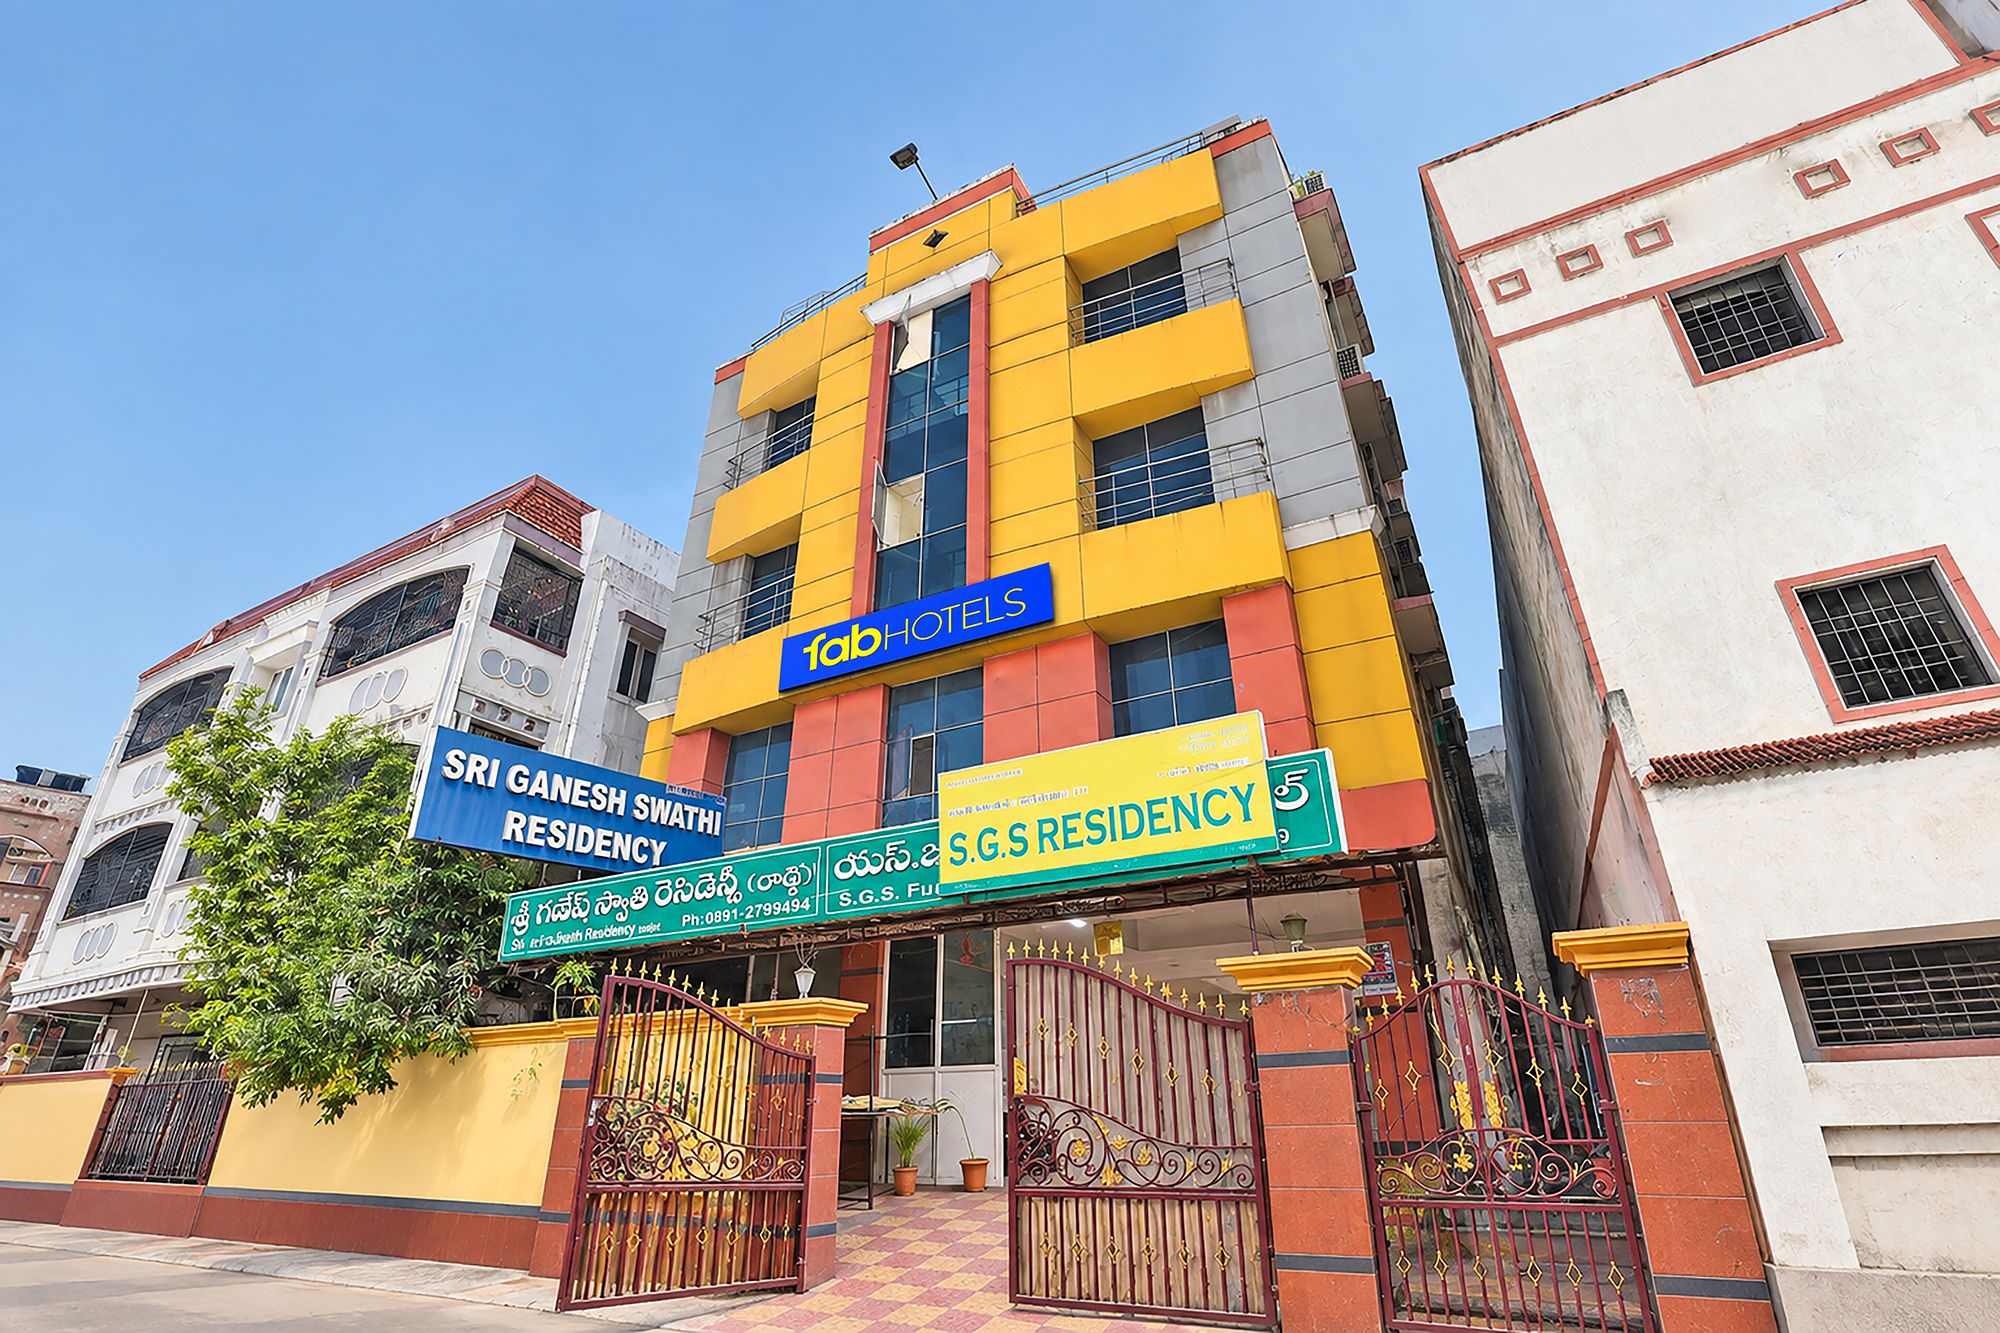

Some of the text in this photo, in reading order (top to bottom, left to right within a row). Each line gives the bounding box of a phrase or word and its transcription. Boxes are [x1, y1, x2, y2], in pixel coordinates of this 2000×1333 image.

[803, 588, 1027, 671] fabHOTELS
[441, 749, 722, 837] SRI GANESH SWATHI
[949, 822, 1029, 867] S.G.S
[1036, 782, 1256, 854] RESIDENCY
[502, 809, 667, 867] RESIDENCY
[682, 897, 811, 927] Ph:0891-2799494
[839, 886, 899, 907] S.G.S.
